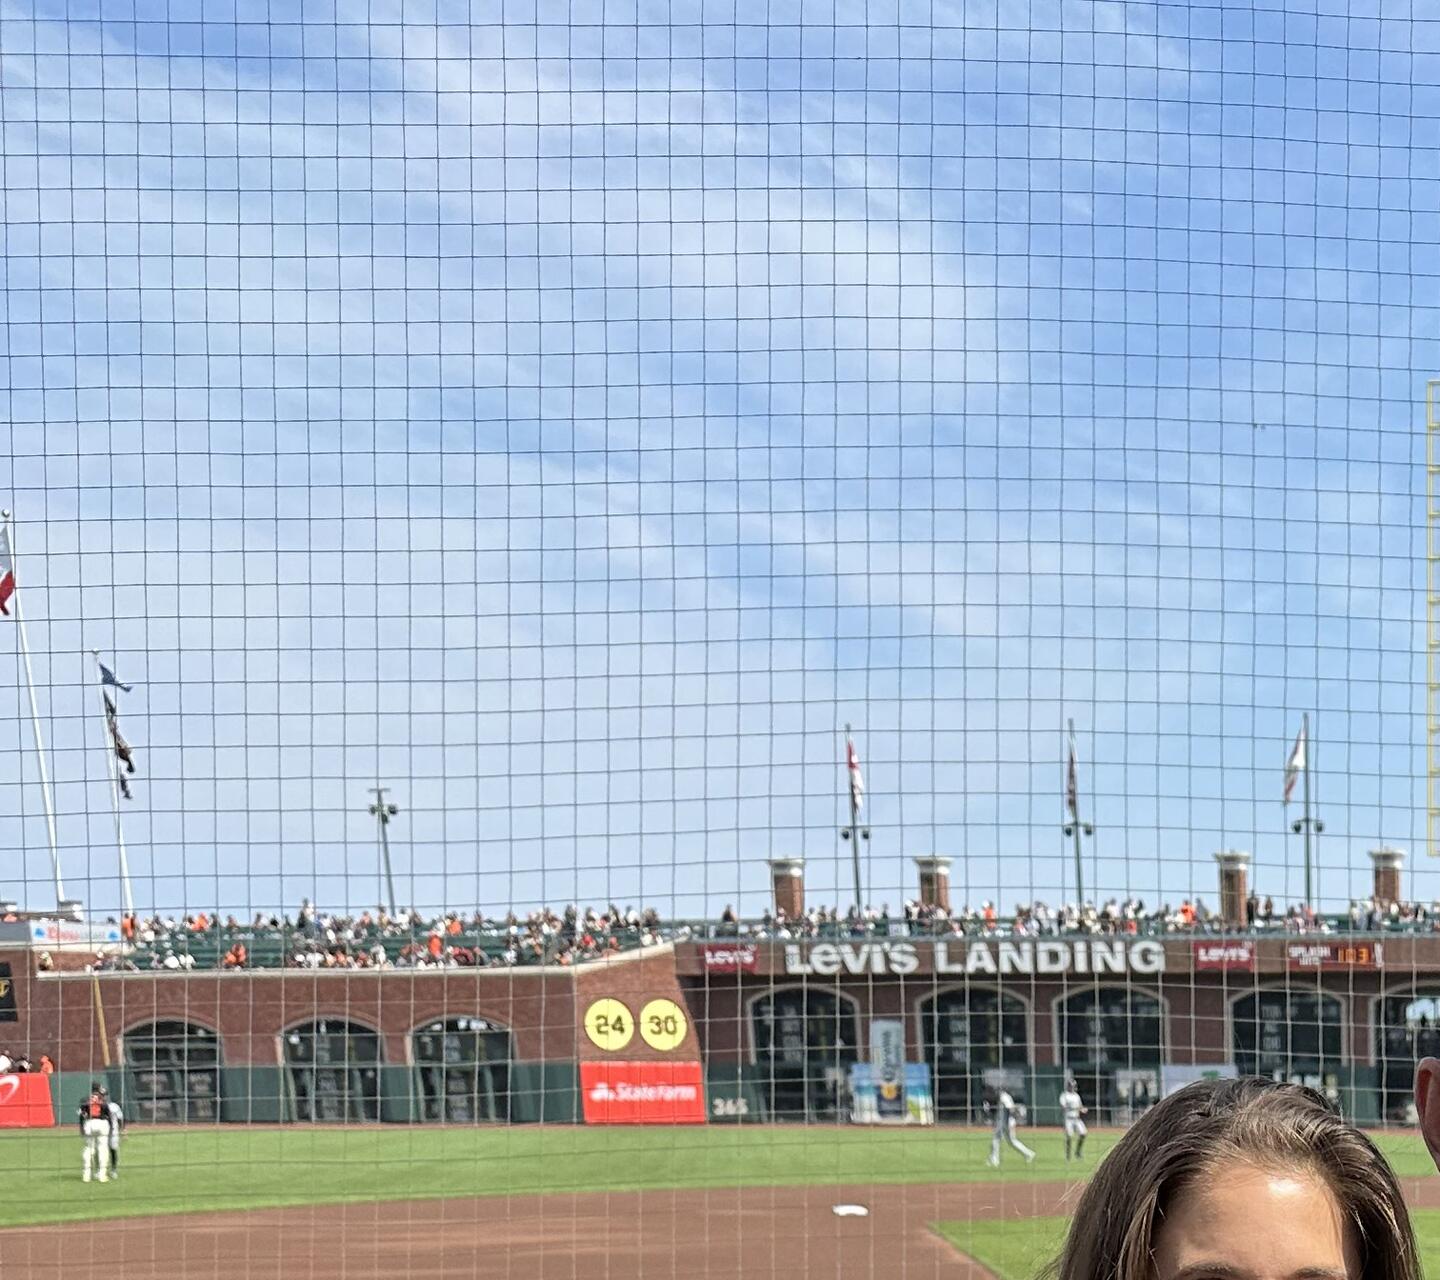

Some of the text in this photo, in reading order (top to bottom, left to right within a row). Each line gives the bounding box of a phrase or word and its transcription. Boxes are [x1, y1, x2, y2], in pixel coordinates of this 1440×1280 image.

[934, 940, 1166, 974] LANDING
[595, 1014, 626, 1035] 24
[650, 1015, 678, 1036] 30
